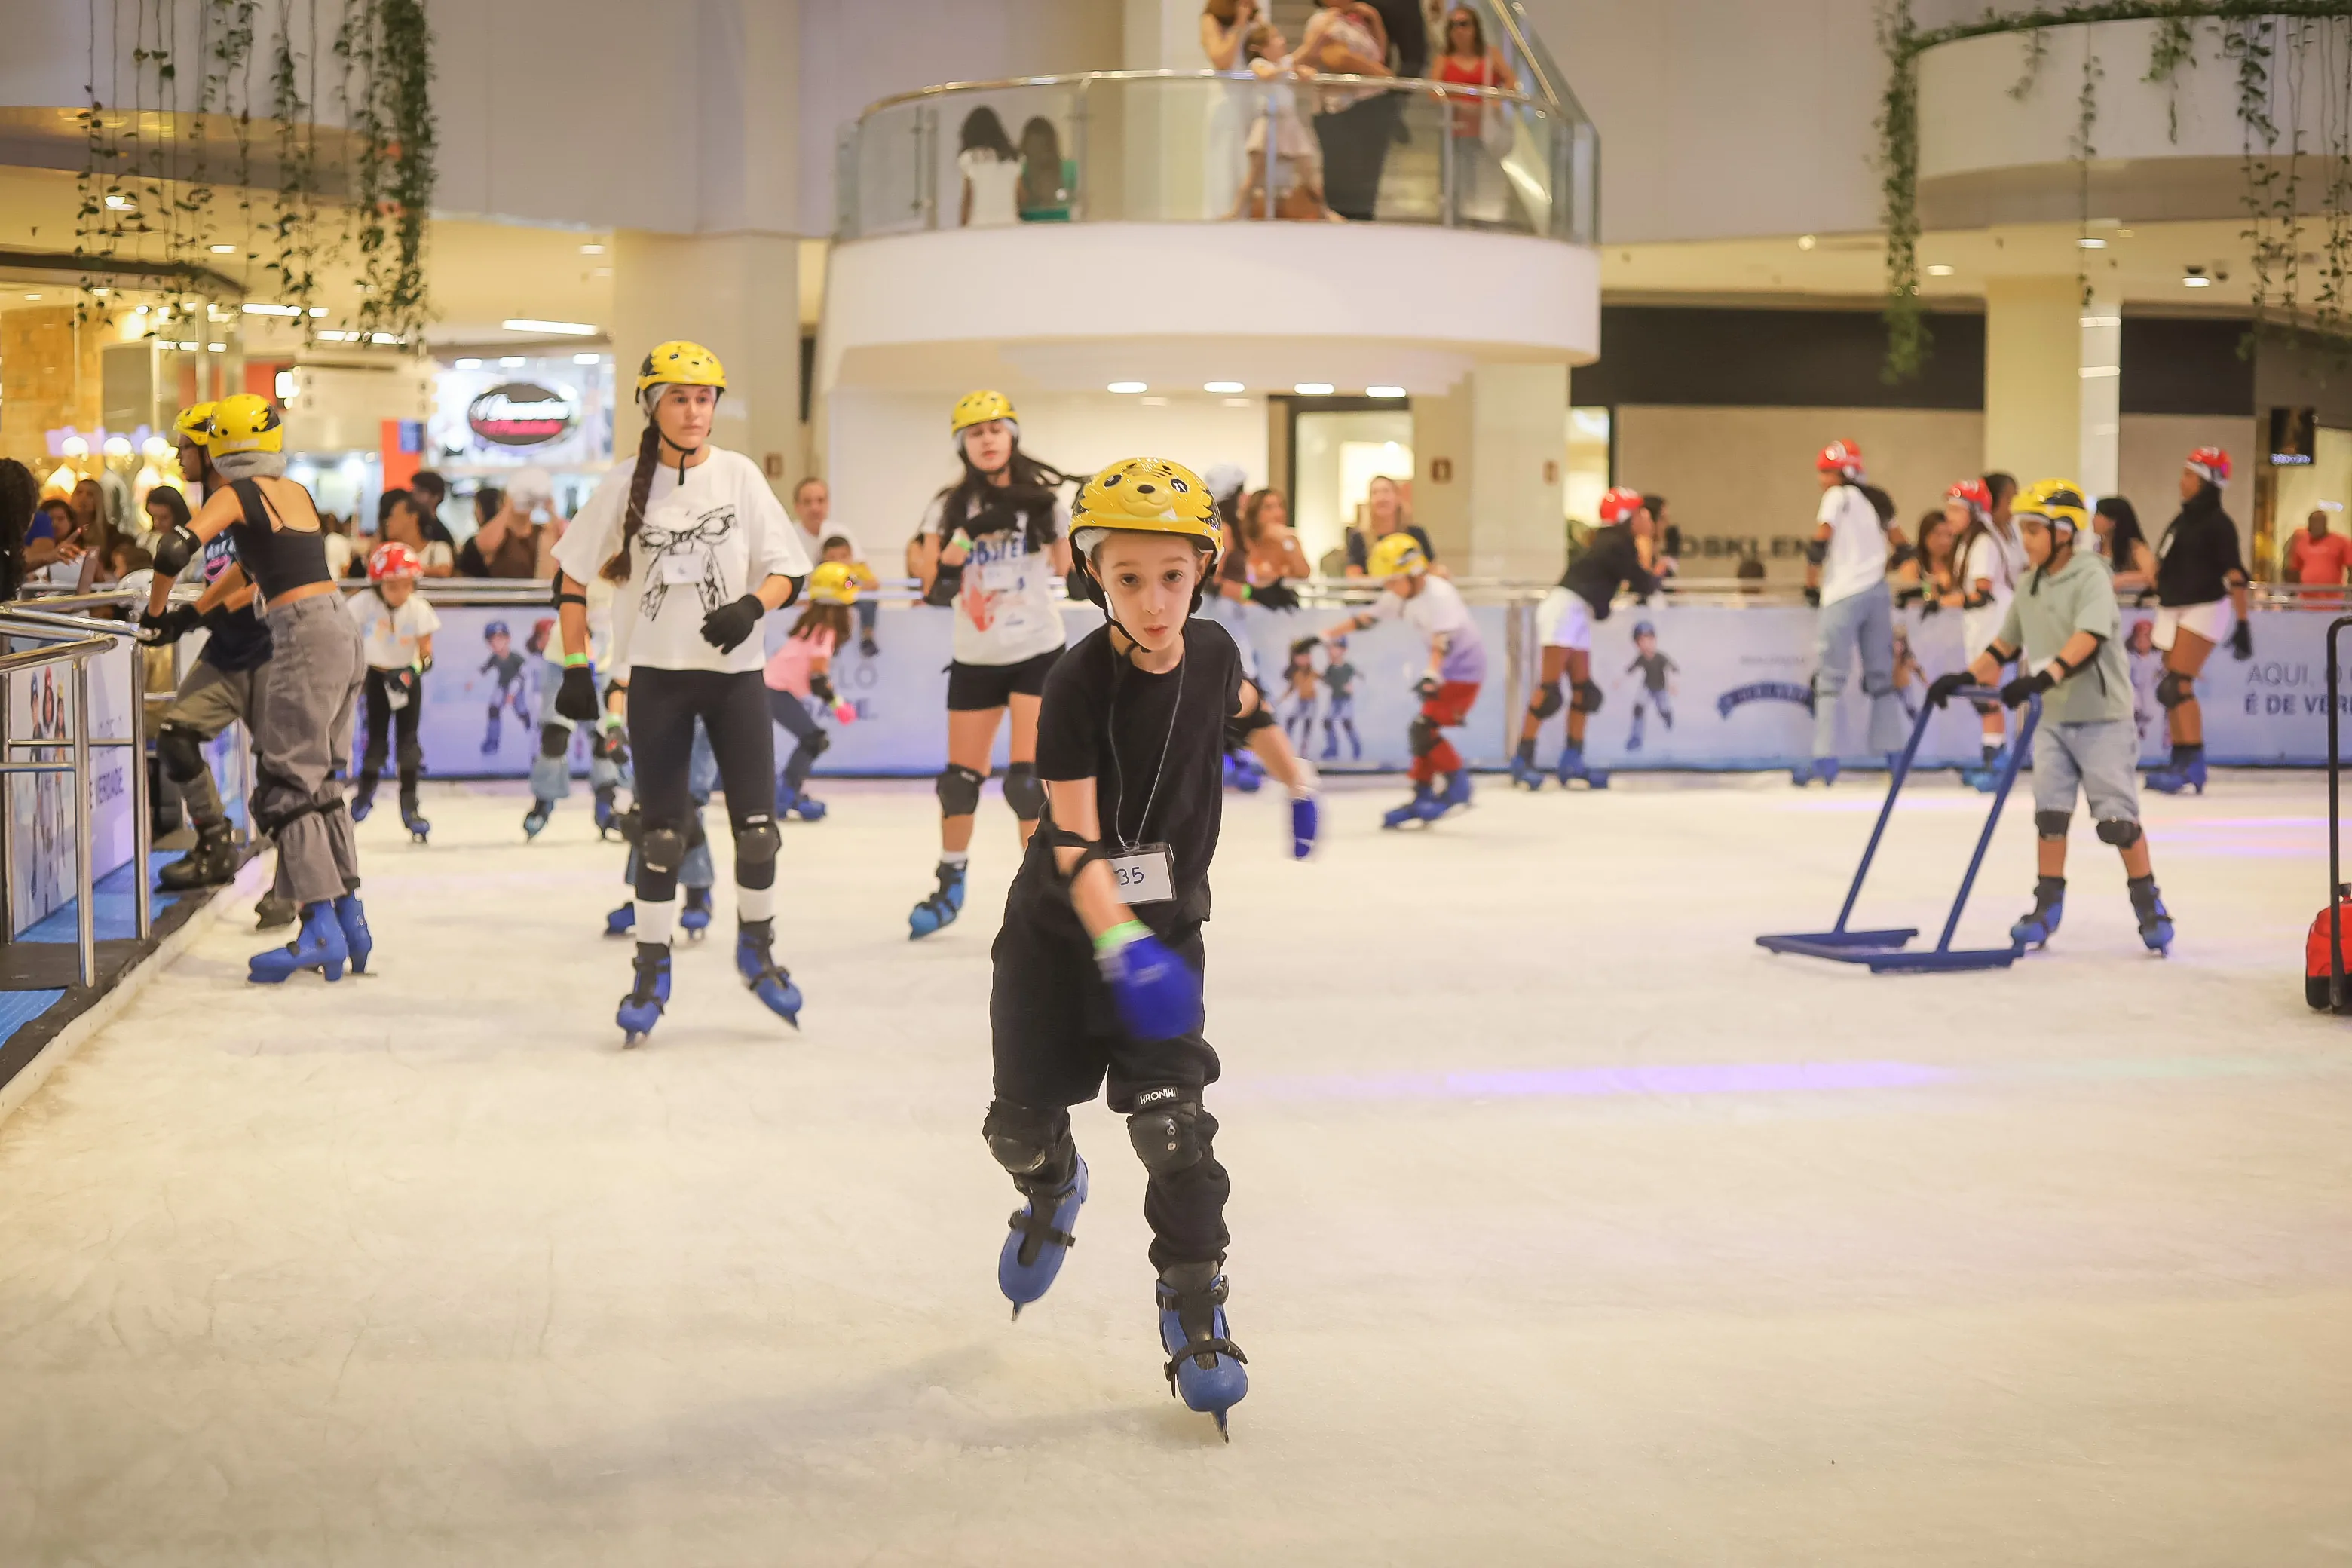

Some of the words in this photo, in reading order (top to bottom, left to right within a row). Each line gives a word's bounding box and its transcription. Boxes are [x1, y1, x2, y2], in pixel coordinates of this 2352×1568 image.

[838, 663, 879, 690] LO
[2265, 693, 2297, 715] DE
[2305, 693, 2352, 715] VER
[1114, 866, 1144, 887] 35
